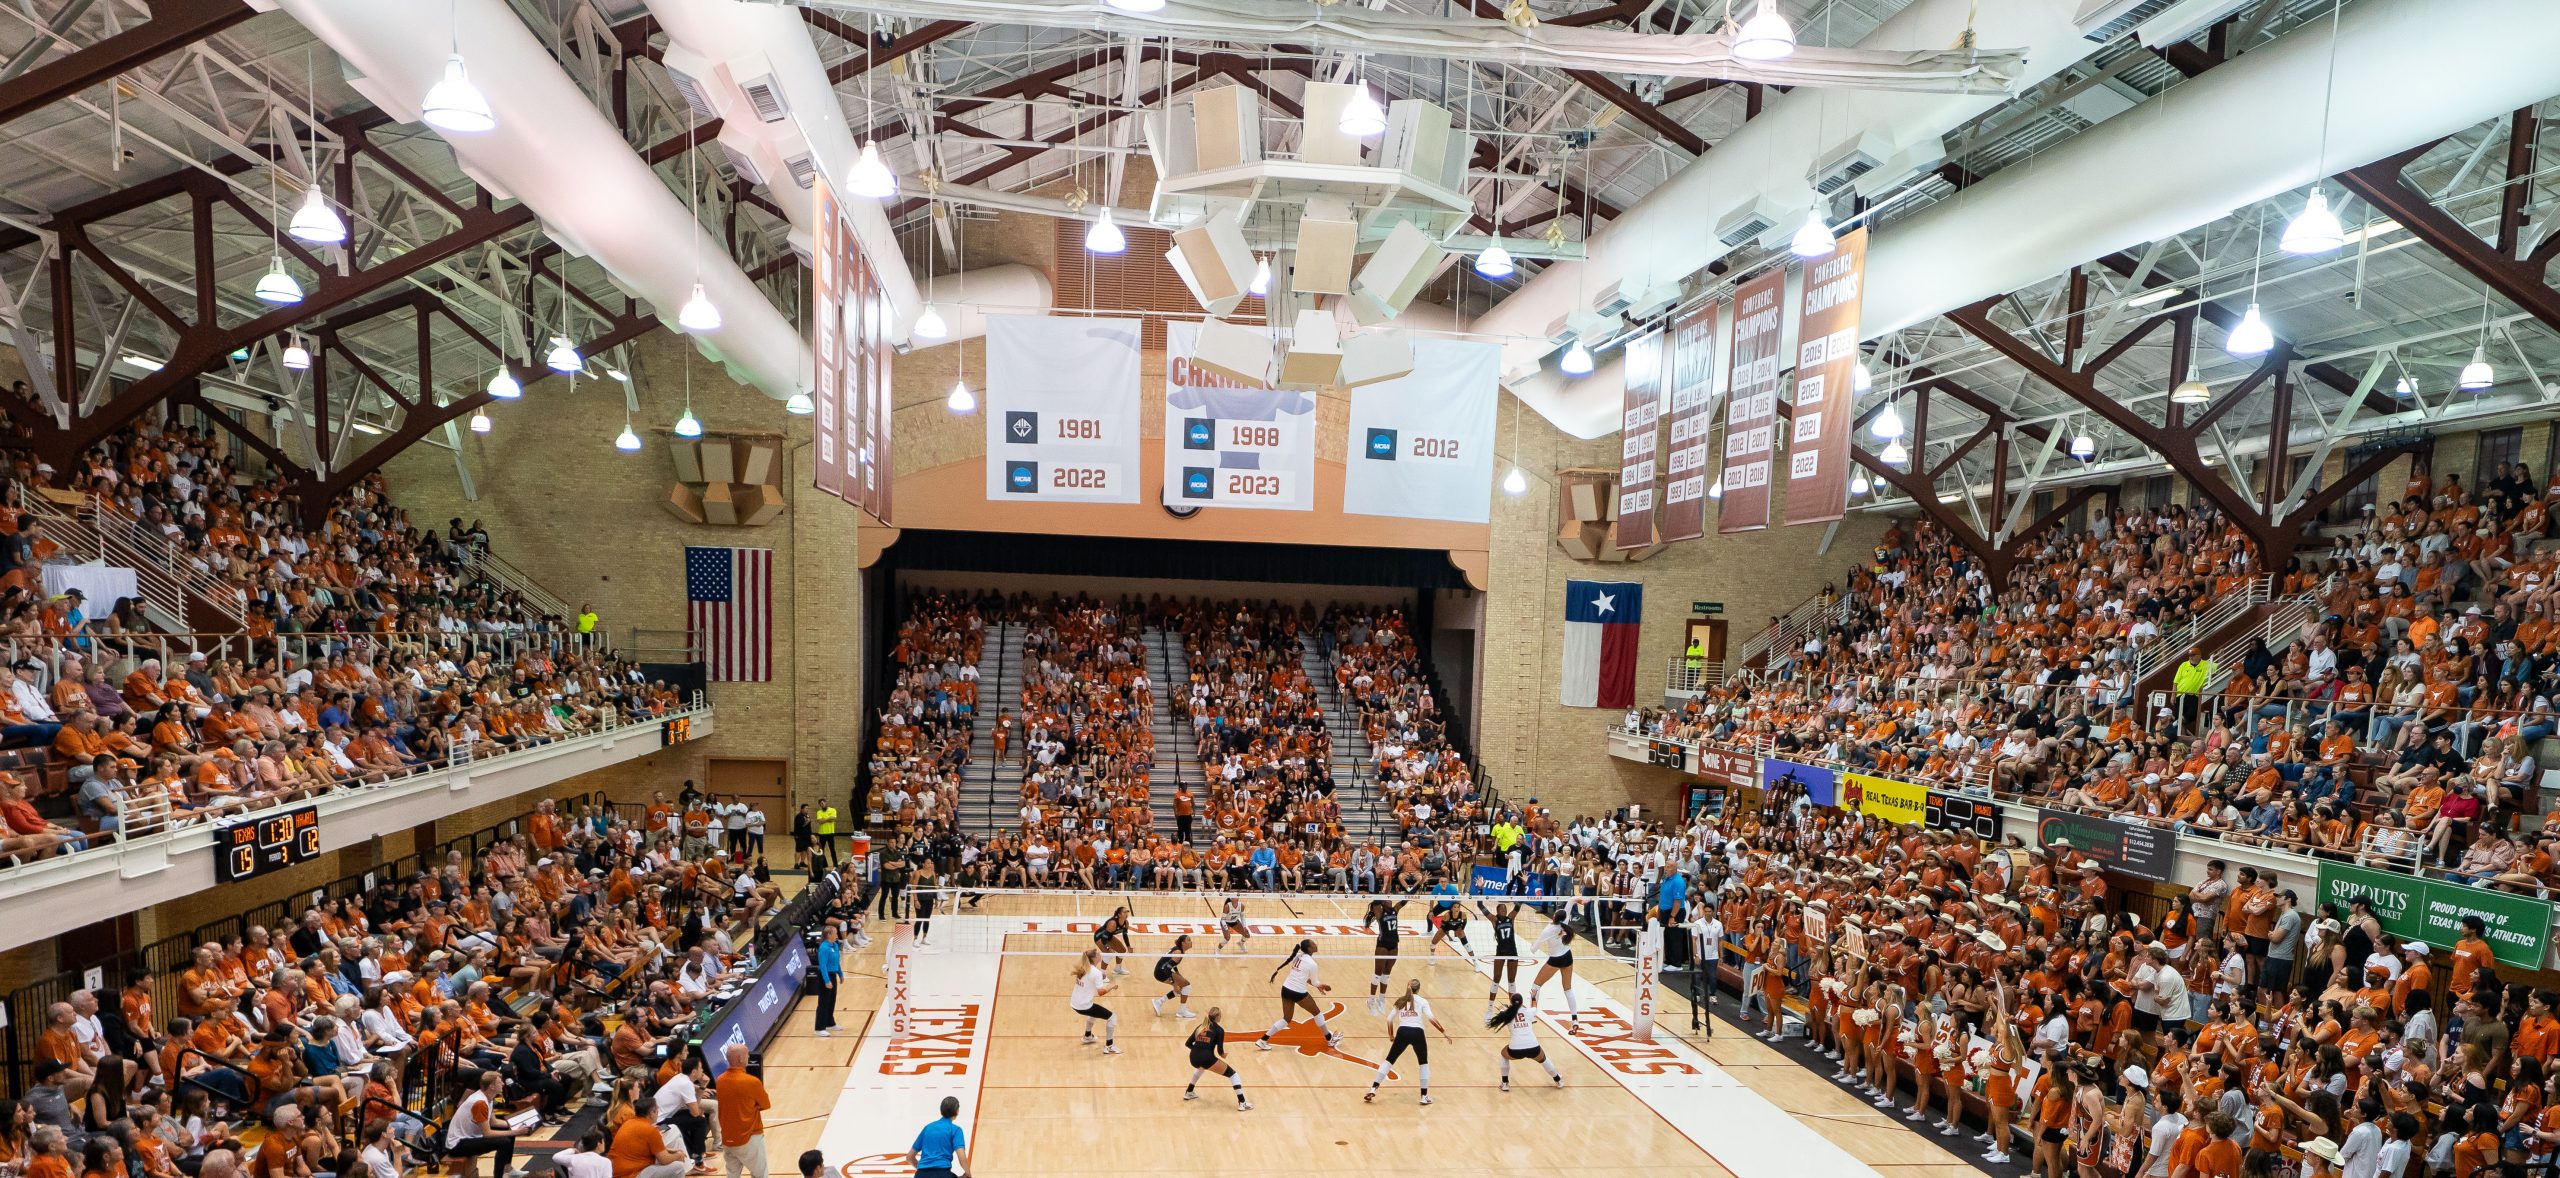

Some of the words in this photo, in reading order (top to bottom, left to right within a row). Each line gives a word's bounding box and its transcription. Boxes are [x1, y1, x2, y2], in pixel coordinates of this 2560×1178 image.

[1814, 252, 1853, 285] CONFERENCE
[1742, 287, 1774, 316] CONFERENCE
[1805, 272, 1858, 316] CHAMPIONS
[1735, 305, 1778, 342] CHAMPIONS
[1804, 343, 1822, 364] 2019
[1736, 369, 1750, 387] 009
[1801, 383, 1820, 402] 2020
[1733, 404, 1746, 421] 2011
[1059, 419, 1101, 439] 1981
[1232, 426, 1280, 446] 1988
[1799, 419, 1816, 437] 2021
[1414, 437, 1459, 459] 2012
[1730, 437, 1744, 454] 2012
[1752, 431, 1767, 449] 2017
[1795, 456, 1814, 474] 2022
[1054, 467, 1105, 489] 2022
[1190, 481, 1208, 489] NCAA
[1229, 474, 1280, 496] 2023
[1728, 471, 1742, 487] 2013
[1749, 466, 1765, 483] 2018
[1866, 790, 1881, 803] REAL
[1881, 793, 1899, 808] TEXAS
[1899, 798, 1925, 812] BAR-B-Q
[234, 825, 255, 845] TEXAS
[270, 815, 294, 843] 1:30
[307, 829, 318, 851] 12
[2069, 823, 2116, 843] Minuteman
[240, 846, 252, 871] 15
[281, 845, 288, 863] 3
[1584, 866, 1596, 887] A
[1602, 876, 1611, 892] S
[2331, 879, 2407, 911] SPROUTS
[2429, 900, 2457, 916] PROUD
[2457, 906, 2495, 926] SPONSOR
[2496, 914, 2510, 926] OF
[1387, 920, 1397, 931] 12
[1500, 928, 1511, 939] 17
[1806, 916, 1824, 940] WE
[2428, 914, 2454, 930] TEXAS
[2492, 929, 2536, 948] ATHLETICS
[91, 976, 97, 989] 2
[893, 954, 909, 1033] TEXAS
[1640, 956, 1653, 1016] EXAS
[1751, 971, 1764, 994] PO
[1514, 1012, 1526, 1023] 12
[2272, 1012, 2289, 1040] IGHT
[879, 1004, 980, 1075] TEXAS
[1542, 1006, 1703, 1075] TEXAS
